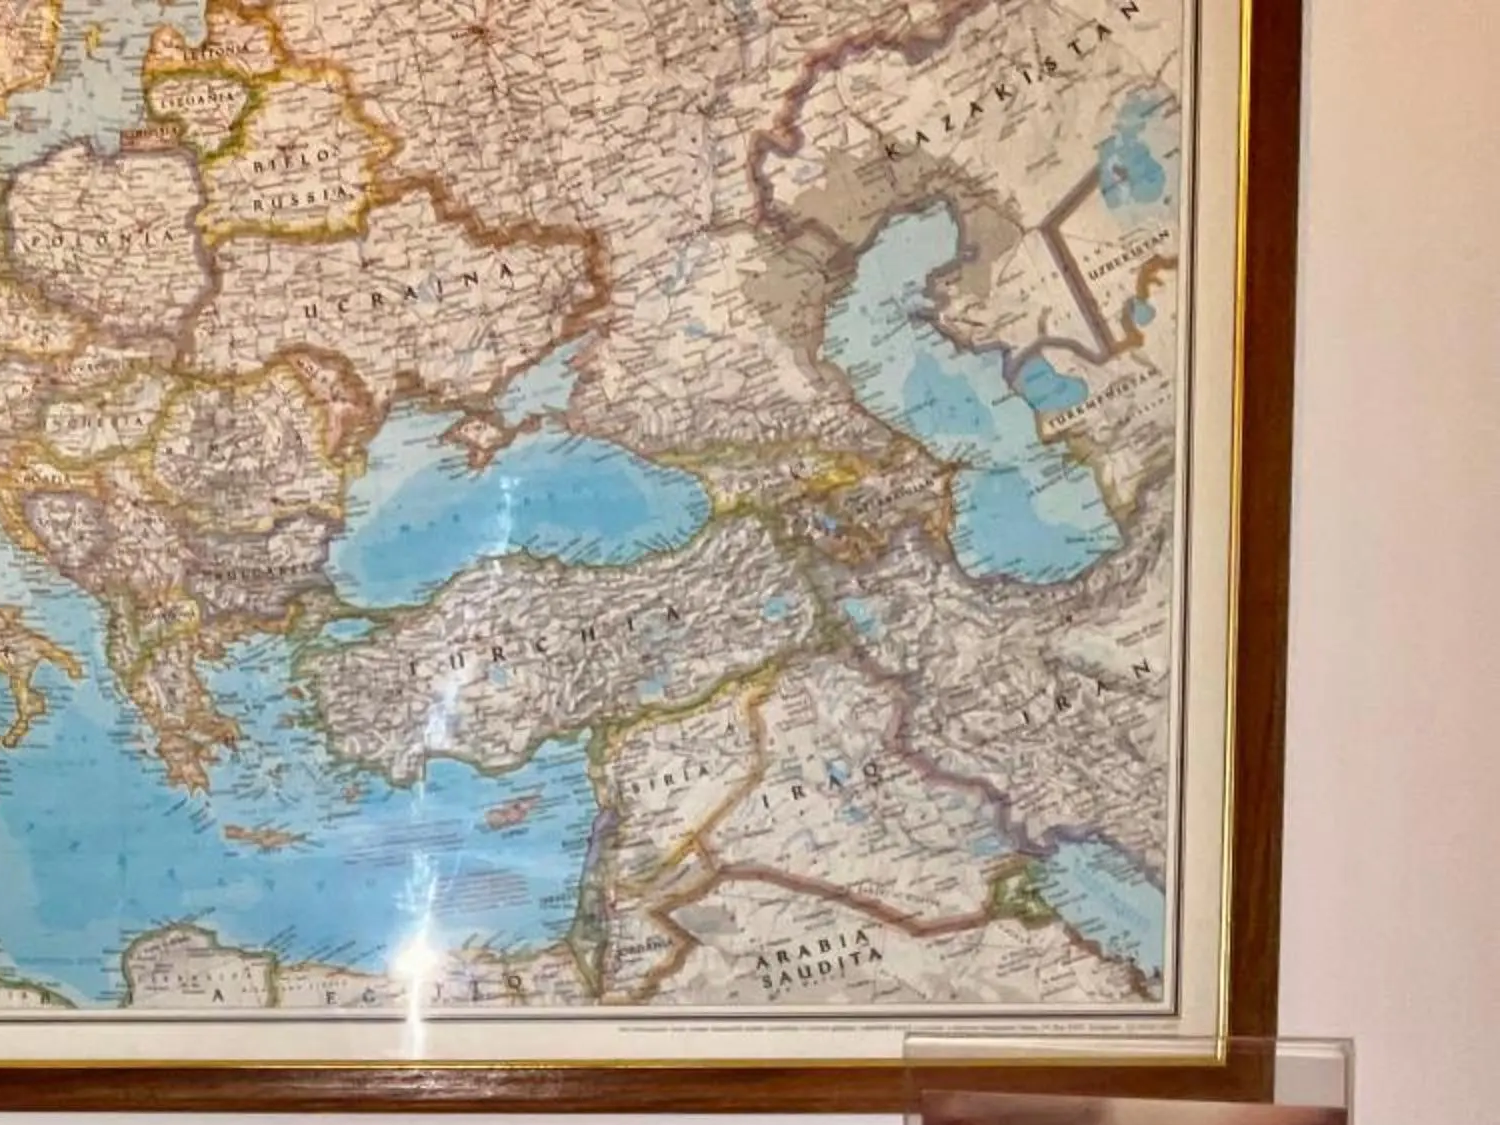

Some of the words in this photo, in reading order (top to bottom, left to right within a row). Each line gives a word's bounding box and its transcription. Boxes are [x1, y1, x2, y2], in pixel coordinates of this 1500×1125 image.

[303, 262, 514, 319] UCRAINA
[408, 605, 682, 678] TURCHIA
[755, 929, 871, 970] ARABIA
[761, 947, 884, 989] SAUDITA
